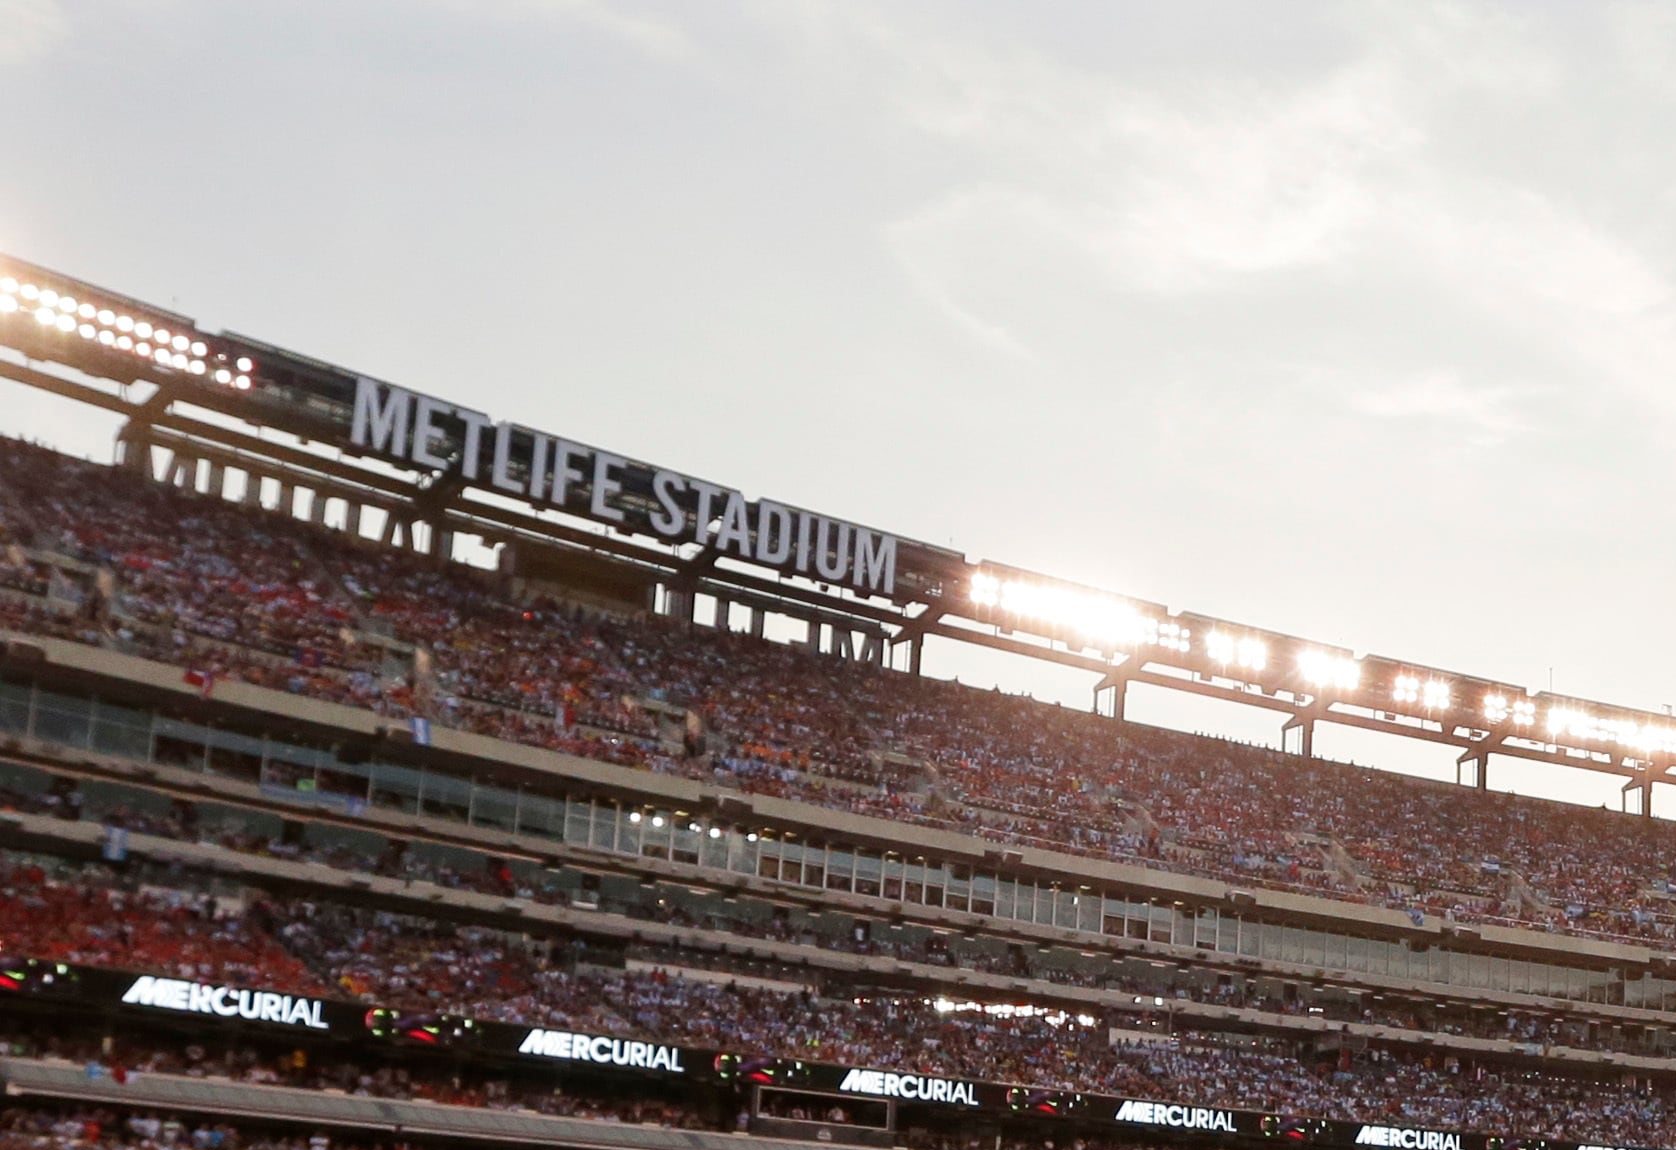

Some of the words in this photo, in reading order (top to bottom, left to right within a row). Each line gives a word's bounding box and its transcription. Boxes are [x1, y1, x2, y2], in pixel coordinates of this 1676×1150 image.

[351, 377, 627, 520] METLIFE
[650, 470, 897, 594] STADIUM
[121, 975, 329, 1029] MERCURIAL
[518, 1028, 685, 1073] MERCURIAL
[839, 1068, 979, 1105] MERCURIAL
[1115, 1100, 1237, 1132] MERCURIAL
